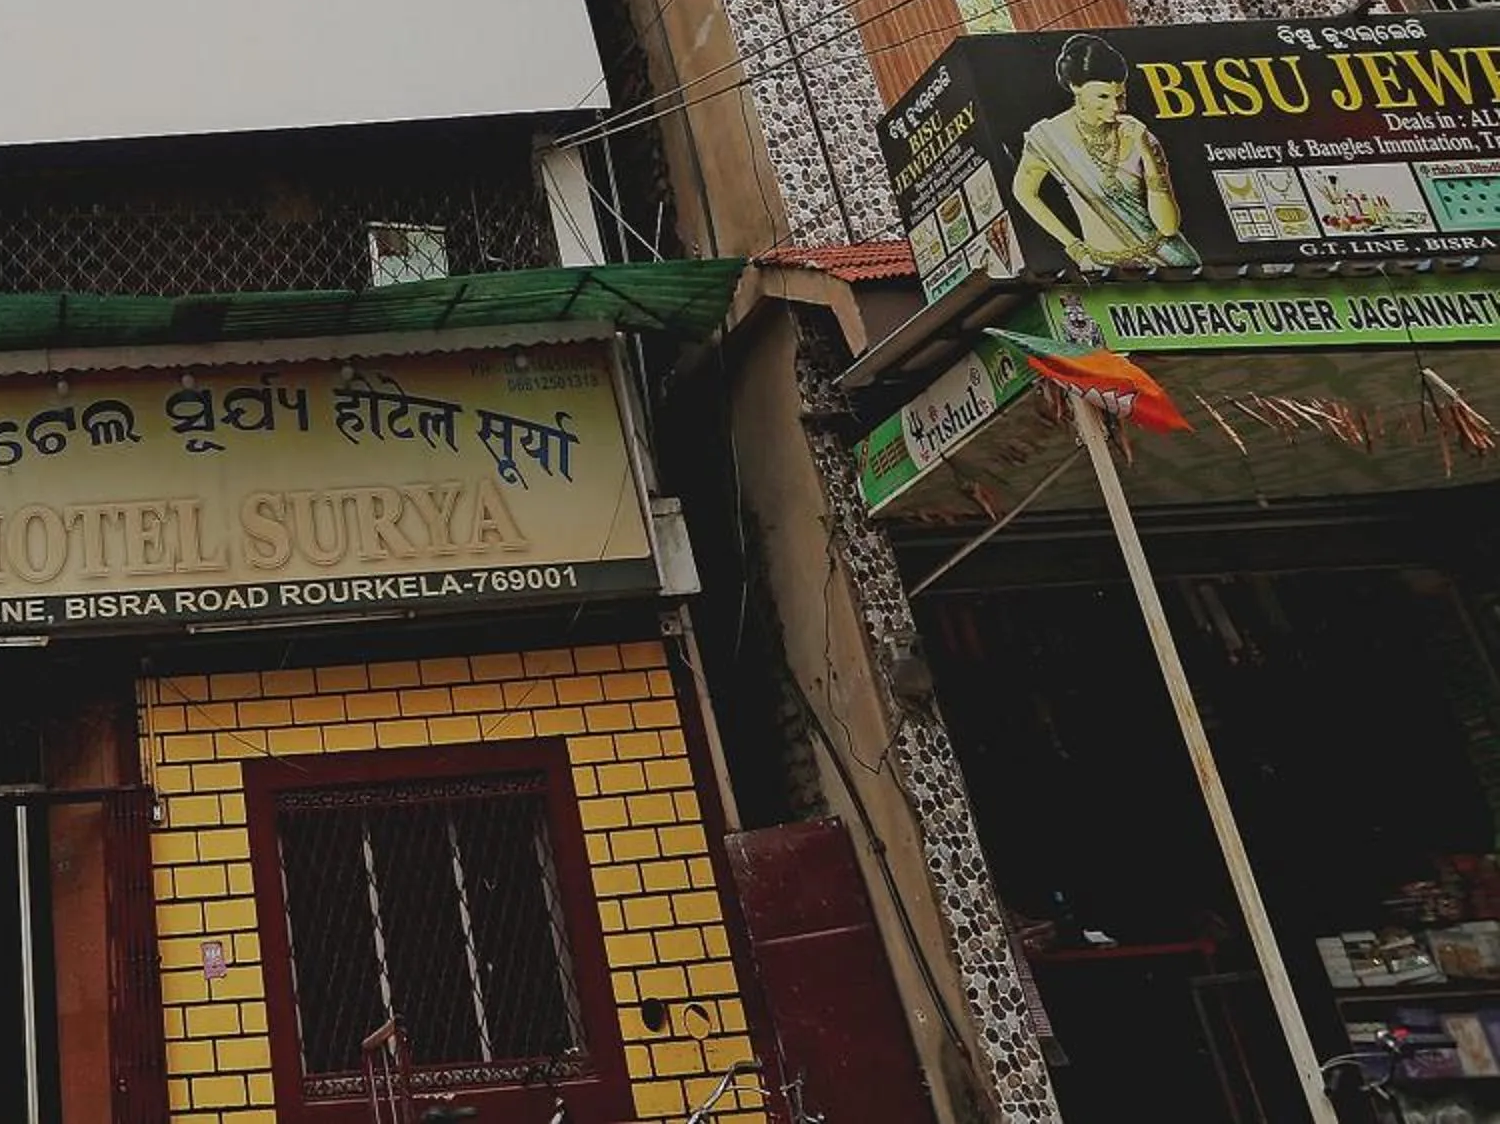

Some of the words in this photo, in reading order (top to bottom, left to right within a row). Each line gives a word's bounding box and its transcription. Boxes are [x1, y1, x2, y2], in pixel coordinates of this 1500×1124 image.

[1135, 56, 1311, 120] BISU
[908, 110, 945, 156] BISU
[1383, 111, 1436, 132] Deals
[1435, 111, 1458, 128] in
[1471, 108, 1500, 127] AL
[894, 101, 977, 196] JEWELLERY
[1204, 141, 1283, 163] Jewellery
[1287, 140, 1303, 158] &
[1304, 137, 1373, 161] Bangles
[1375, 132, 1481, 153] Immitation,
[1351, 239, 1409, 255] LINE
[1424, 235, 1497, 251] BISRA
[1108, 299, 1343, 338] MANUFACTURER
[239, 476, 531, 571] SURYA
[65, 592, 167, 620] BISRA
[175, 585, 269, 614] ROAD
[279, 564, 578, 606] ROURKELA-769001
